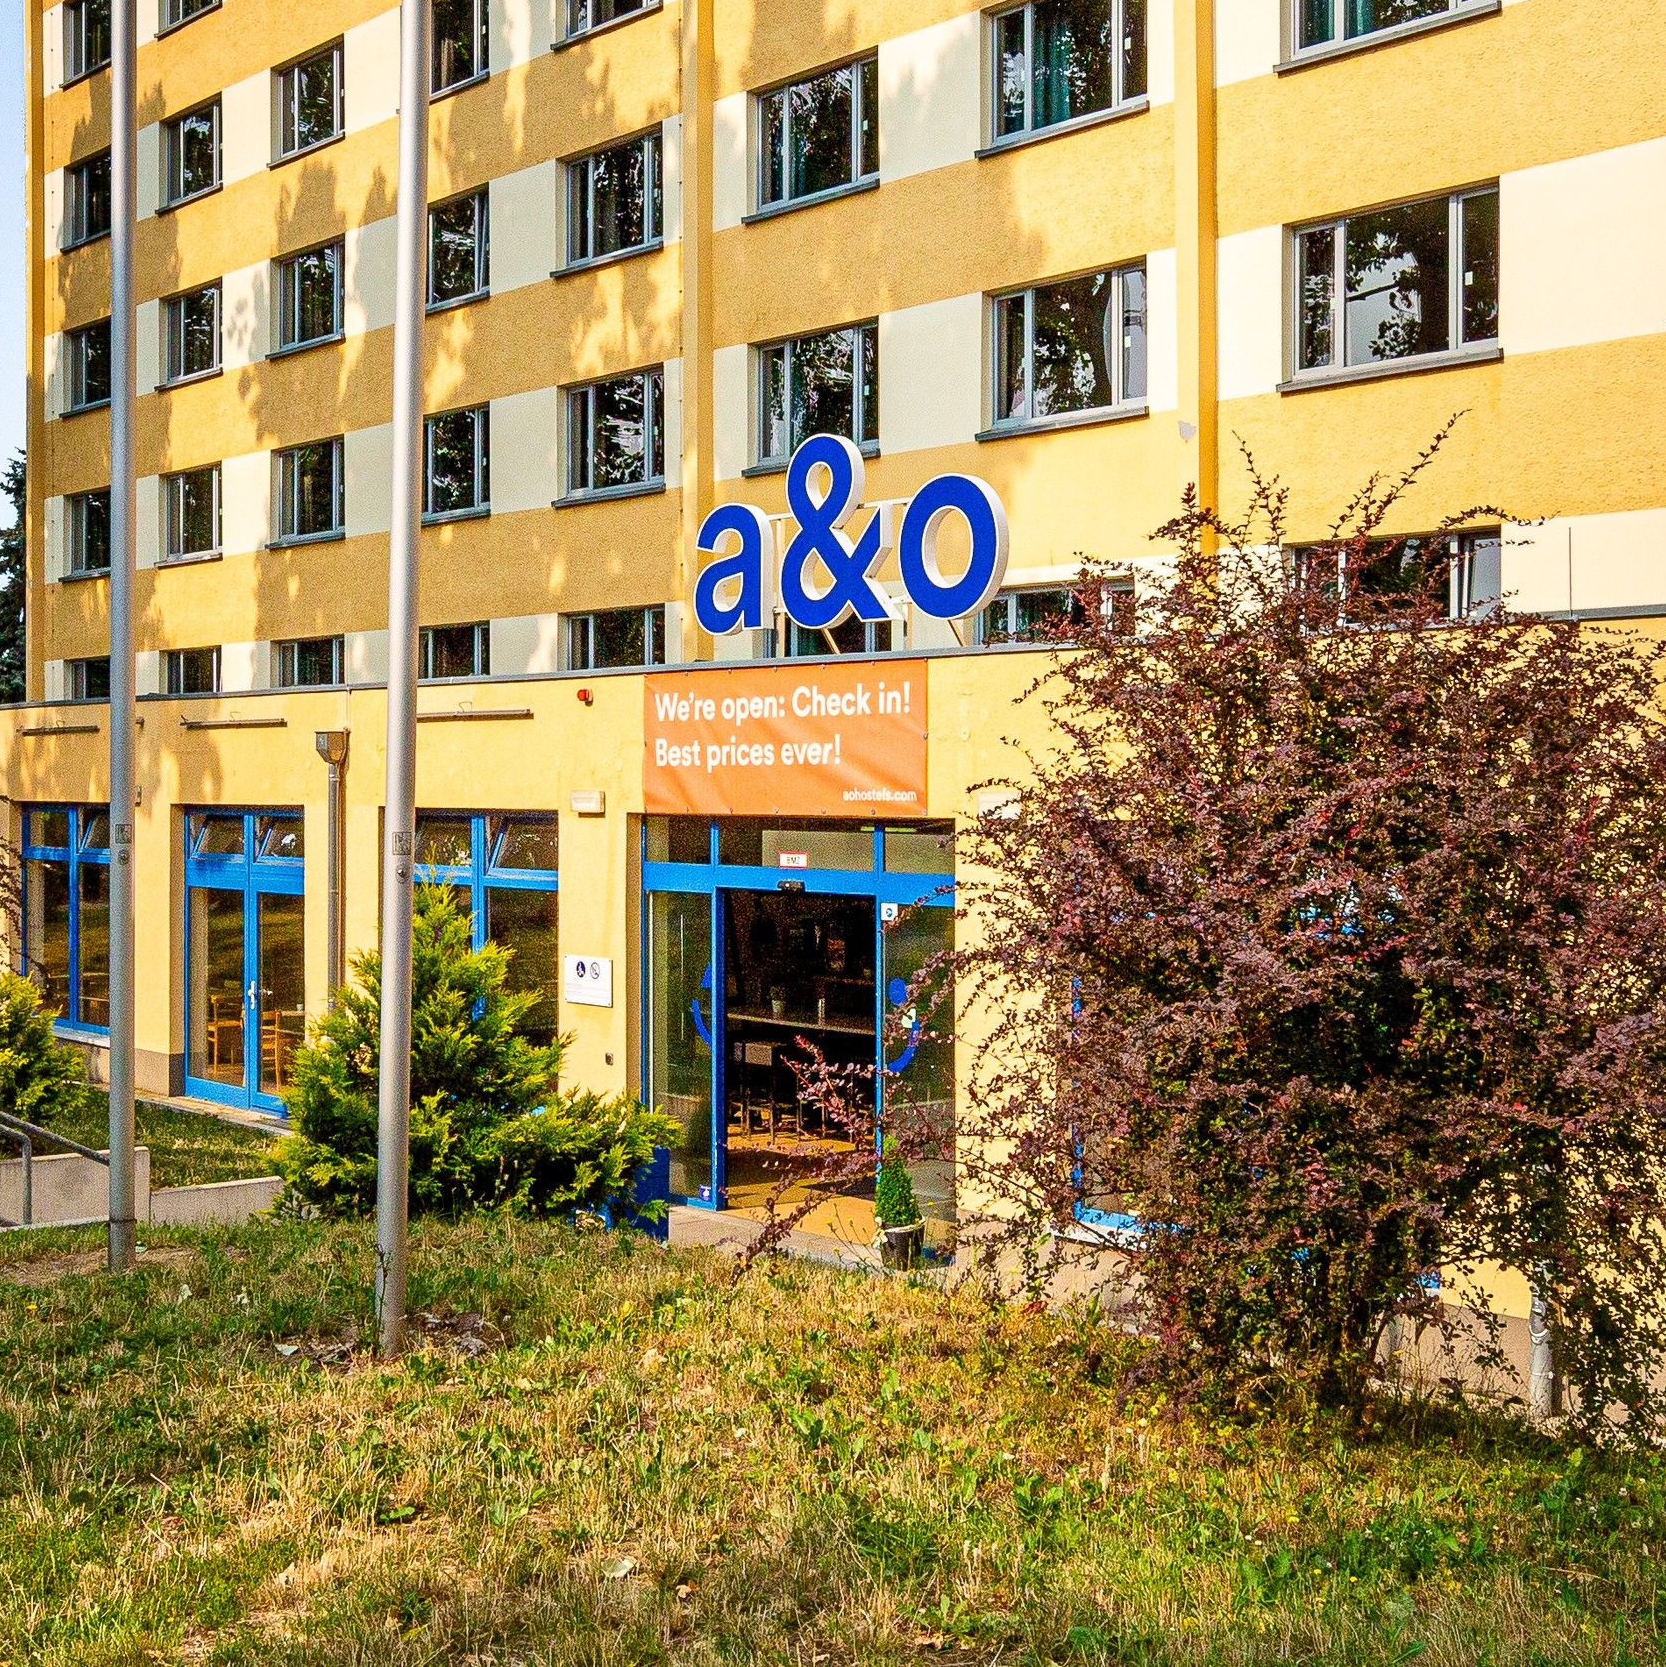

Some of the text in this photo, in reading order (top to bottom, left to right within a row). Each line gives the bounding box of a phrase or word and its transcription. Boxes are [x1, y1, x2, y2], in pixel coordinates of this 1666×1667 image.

[694, 433, 1002, 635] a&o
[654, 680, 911, 726] We're open: Check in!
[654, 733, 841, 773] Best prices ever!
[842, 786, 918, 802] aohostels.com
